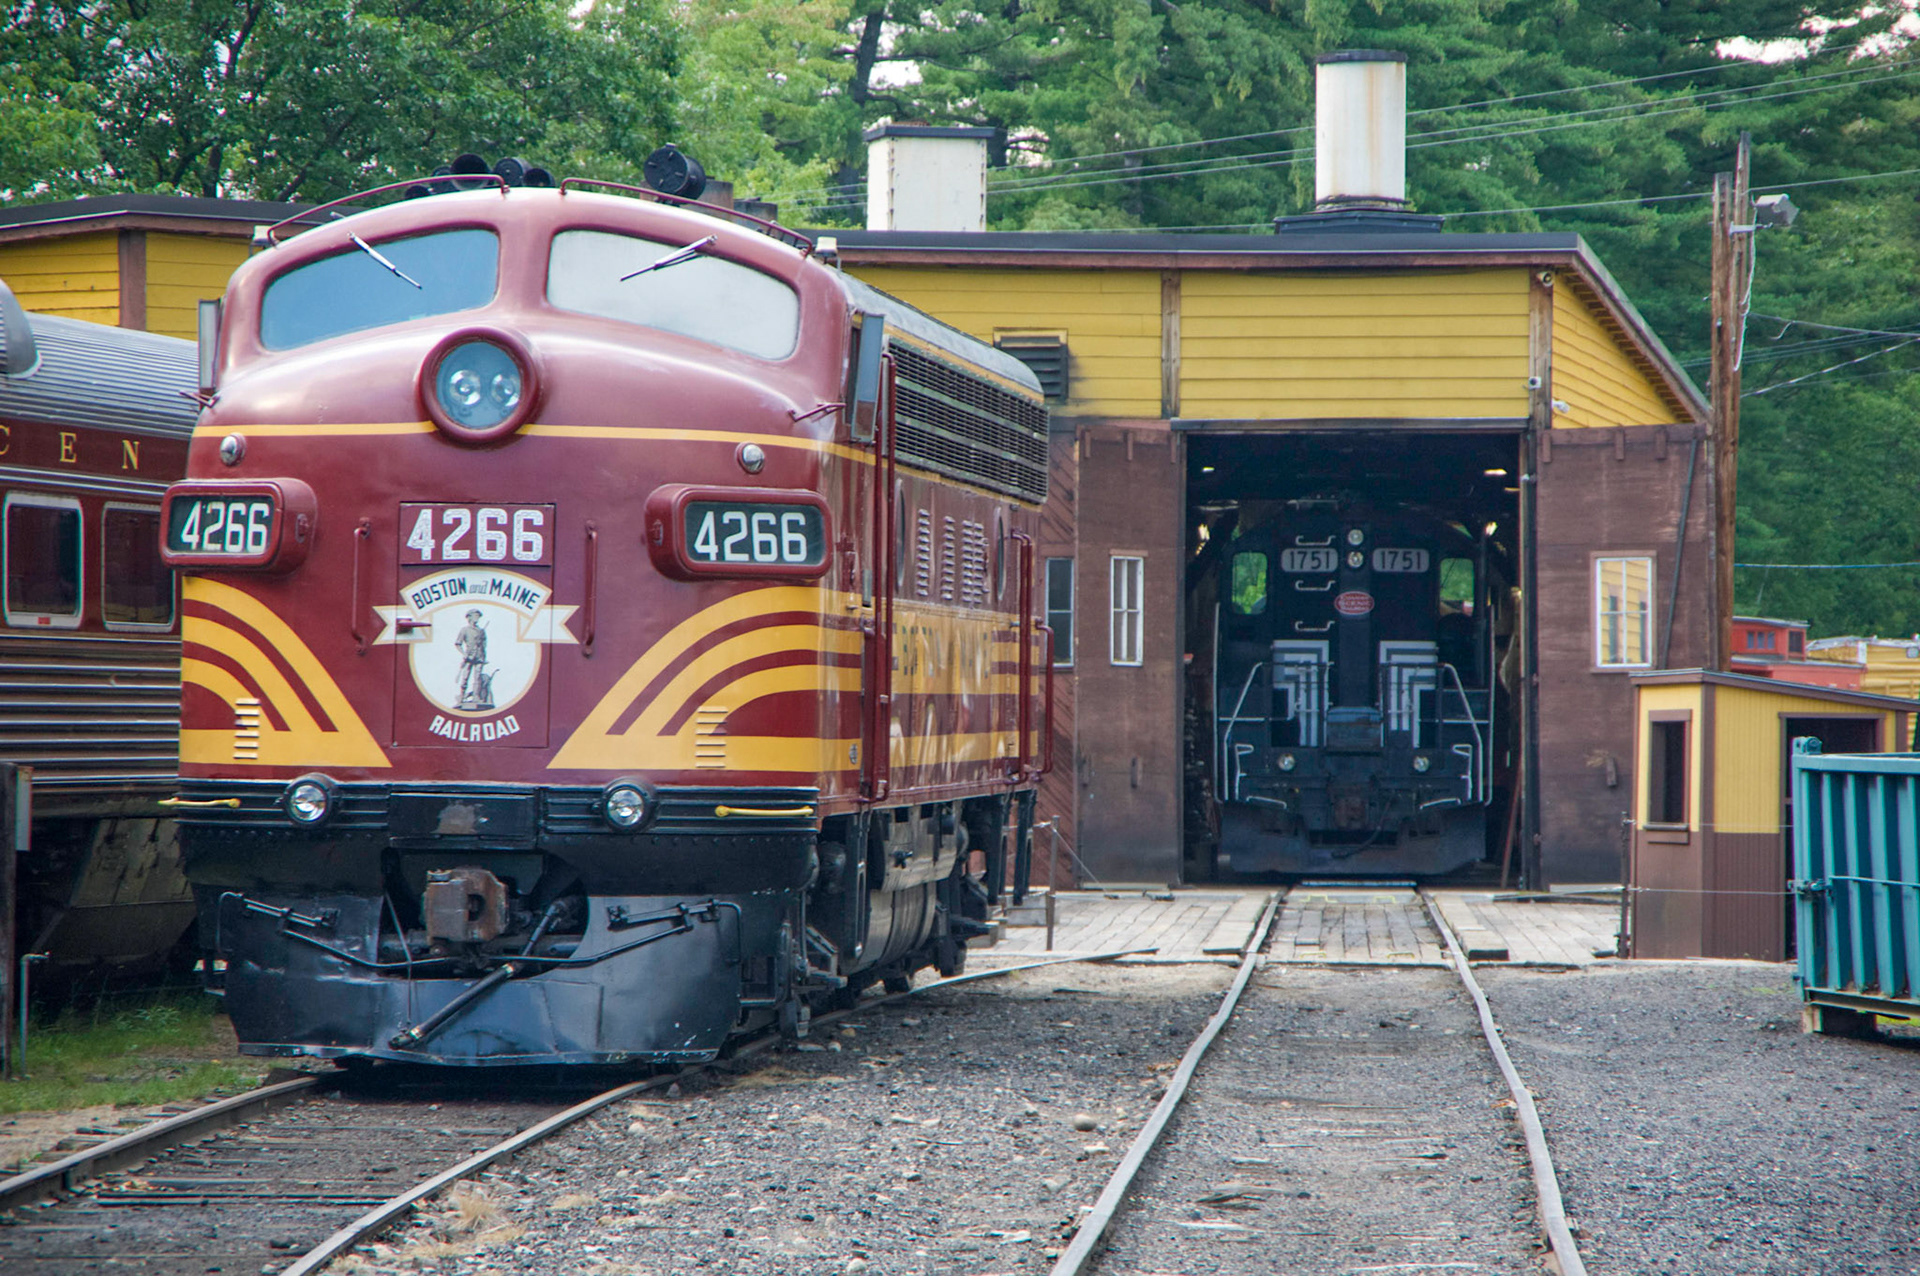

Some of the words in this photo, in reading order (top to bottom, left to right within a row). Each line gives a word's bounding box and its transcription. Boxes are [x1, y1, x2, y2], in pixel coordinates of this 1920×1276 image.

[180, 501, 270, 552] 4266
[406, 508, 544, 561] 4266
[693, 511, 807, 562] 4266
[1289, 551, 1331, 570] 1751
[1381, 551, 1422, 570] 1751
[411, 577, 467, 610] BOSTON
[469, 580, 487, 595] and
[488, 578, 540, 610] MAINE
[429, 714, 520, 742] RAILROAD
